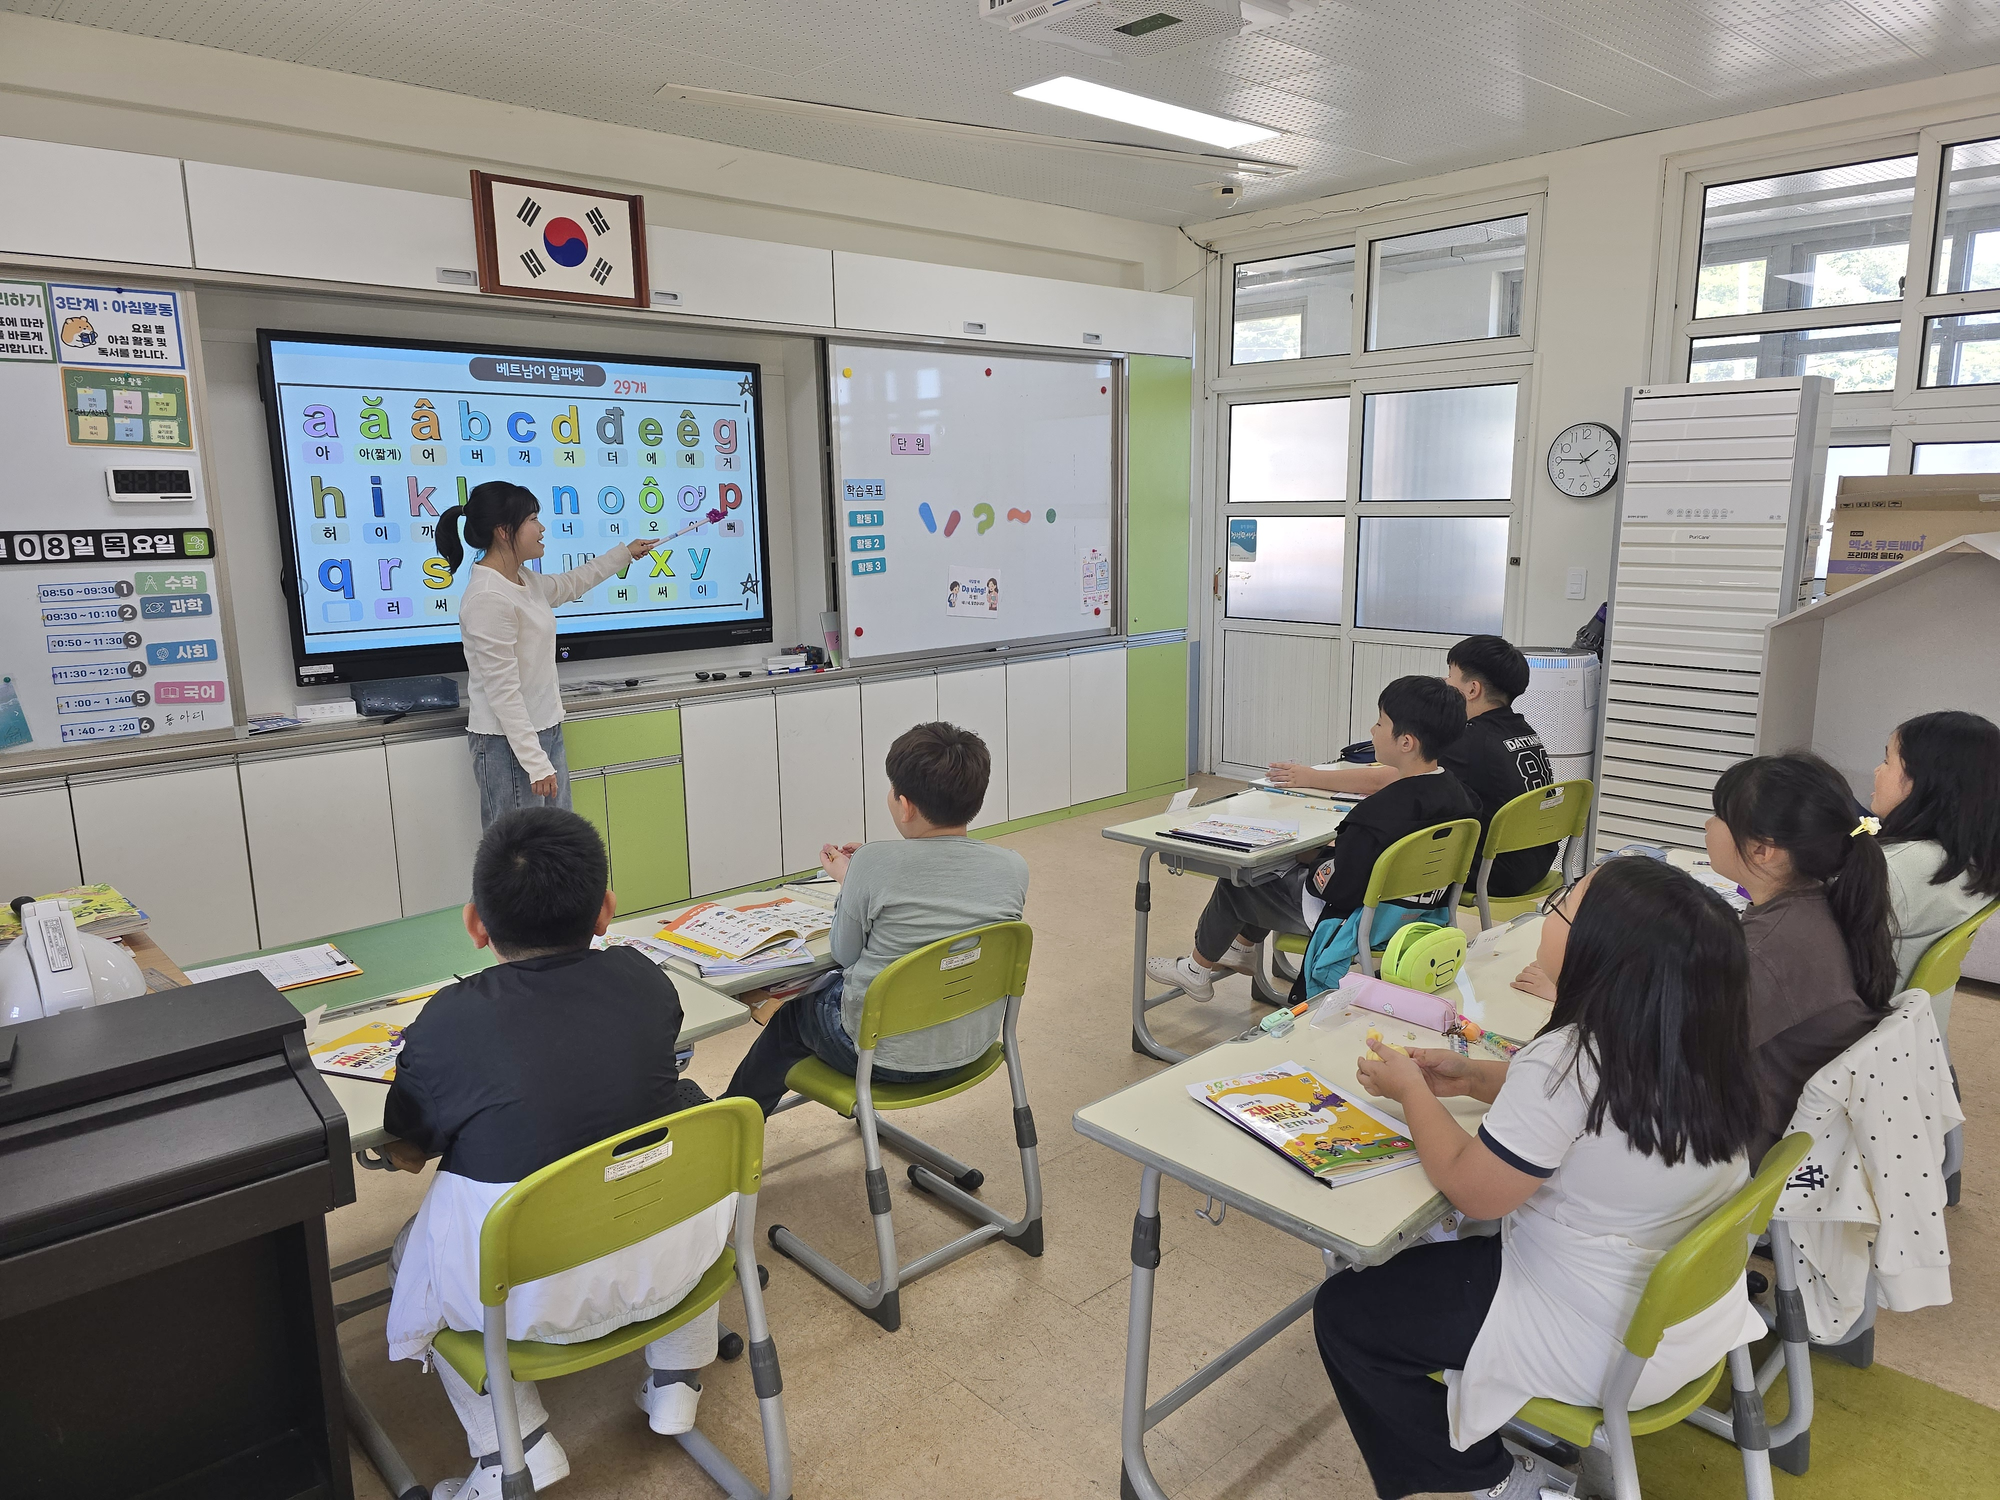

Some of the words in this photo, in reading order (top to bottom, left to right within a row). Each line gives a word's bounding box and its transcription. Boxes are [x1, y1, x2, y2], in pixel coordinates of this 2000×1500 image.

[56, 296, 100, 312] 3단계
[111, 299, 173, 317] 아침활동
[20, 317, 44, 328] 따라
[131, 323, 152, 334] 요일
[154, 324, 165, 335] 별
[8, 330, 43, 341] 바르게
[107, 334, 129, 346] 아침
[131, 335, 154, 347] 활동
[156, 337, 167, 348] 및
[98, 347, 130, 359] 독서를
[132, 348, 168, 360] 합니다.
[496, 363, 546, 380] 베트남어
[549, 365, 585, 382] 알파벳
[613, 380, 647, 395] 29개
[303, 404, 339, 438] a
[360, 396, 392, 439] ă
[411, 398, 442, 441] â
[458, 400, 491, 441] b
[507, 411, 537, 443] c
[552, 405, 581, 444] d
[596, 406, 624, 445] đ
[638, 417, 663, 446] e
[677, 409, 700, 447] ê
[713, 418, 738, 454] g
[1571, 432, 1578, 443] 11
[1582, 428, 1592, 440] 12
[1598, 431, 1602, 442] 1
[897, 437, 907, 451] 단
[915, 437, 925, 451] 원
[1560, 443, 1572, 454] 10
[1604, 440, 1614, 452] 2
[315, 446, 330, 461] 아
[359, 448, 402, 462] 아(짧게)
[422, 449, 435, 462] 어
[471, 449, 484, 463] 버
[518, 450, 531, 464] 꺼
[564, 450, 575, 464] 저
[607, 451, 618, 464] 더
[646, 452, 657, 465] 에
[685, 452, 695, 465] 에
[723, 456, 733, 469] 거
[1555, 456, 1562, 466] 9
[1608, 453, 1617, 465] 3
[1557, 468, 1565, 479] 8
[1602, 468, 1611, 479] 4
[1568, 478, 1575, 489] 7
[1579, 481, 1588, 492] 6
[1592, 478, 1601, 489] 5
[311, 476, 347, 518] h
[370, 476, 385, 517] i
[407, 476, 439, 517] k
[552, 485, 580, 514] n
[598, 486, 625, 514] o
[639, 476, 664, 514] ô
[677, 485, 706, 512] ơ
[719, 483, 742, 513] p
[846, 484, 883, 498] 학습목표
[856, 513, 872, 525] 활동
[873, 514, 878, 523] 1
[323, 527, 337, 541] 허
[375, 526, 388, 541] 이
[421, 525, 435, 539] 까
[562, 522, 573, 535] 너
[610, 523, 620, 535] 어
[648, 521, 659, 532] 오
[103, 533, 176, 557] 목요일
[857, 538, 872, 549] 활동
[873, 538, 880, 548] 2
[1848, 539, 1872, 551] 엑소
[1875, 539, 1925, 552] 큐트베어
[1846, 551, 1879, 560] 프리미엄
[1880, 552, 1904, 560] 물티슈
[858, 562, 873, 573] 활동
[875, 561, 881, 571] 3
[318, 558, 355, 599] q
[378, 558, 402, 591] r
[422, 557, 453, 590] s
[649, 550, 675, 577] x
[688, 548, 711, 580] y
[164, 575, 198, 590] 수학
[119, 583, 128, 596] 1
[170, 597, 203, 614] 과학
[387, 601, 400, 615] 러
[435, 599, 448, 612] 써
[617, 588, 628, 601] 버
[657, 586, 668, 598] 써
[697, 584, 707, 596] 이
[124, 608, 132, 619] 2
[127, 635, 137, 645] 3
[176, 643, 209, 659] 사회
[132, 664, 143, 675] 4
[136, 692, 145, 703] 5
[183, 685, 216, 700] 국어
[141, 719, 150, 731] 6
[333, 1045, 384, 1066] 재미난
[1243, 1102, 1300, 1118] 재미난
